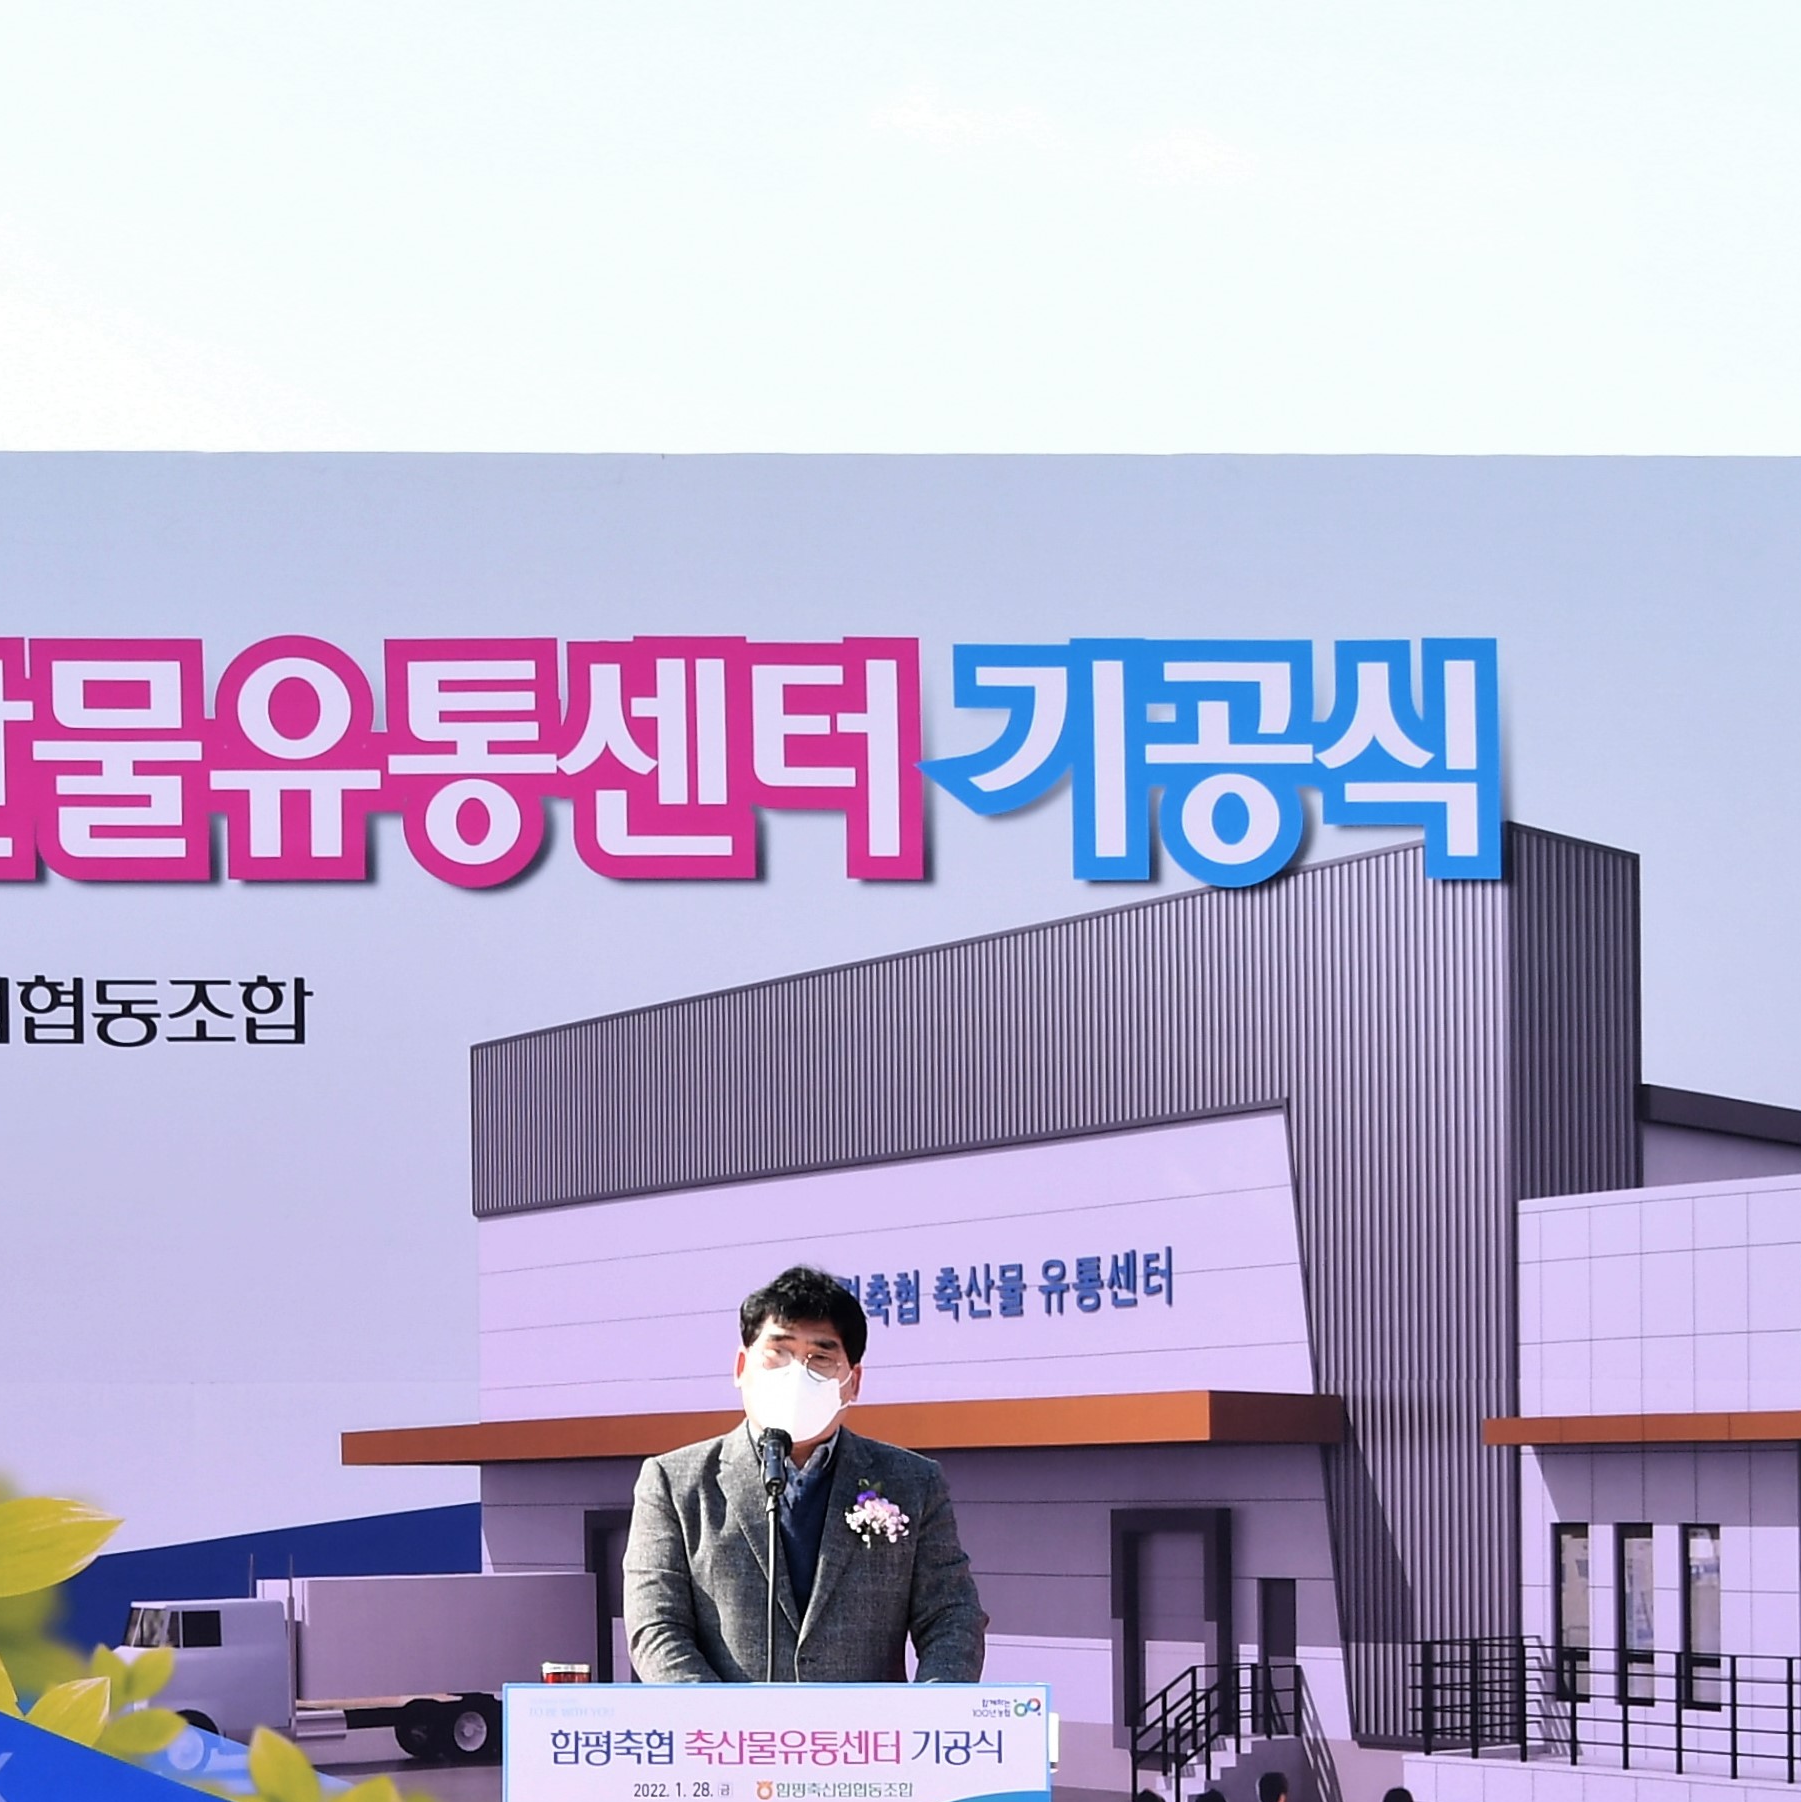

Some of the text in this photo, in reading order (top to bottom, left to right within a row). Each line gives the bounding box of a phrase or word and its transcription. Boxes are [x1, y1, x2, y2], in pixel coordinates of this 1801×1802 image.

[966, 657, 1481, 867] 기공식
[933, 1262, 1025, 1322] 축산물
[1038, 1245, 1175, 1316] 유통센터
[550, 1729, 1003, 1767] 함평축협 축산물유통센터 기공식
[633, 1783, 670, 1798] 2022.
[676, 1782, 687, 1798] 1.
[692, 1782, 714, 1798] 28.
